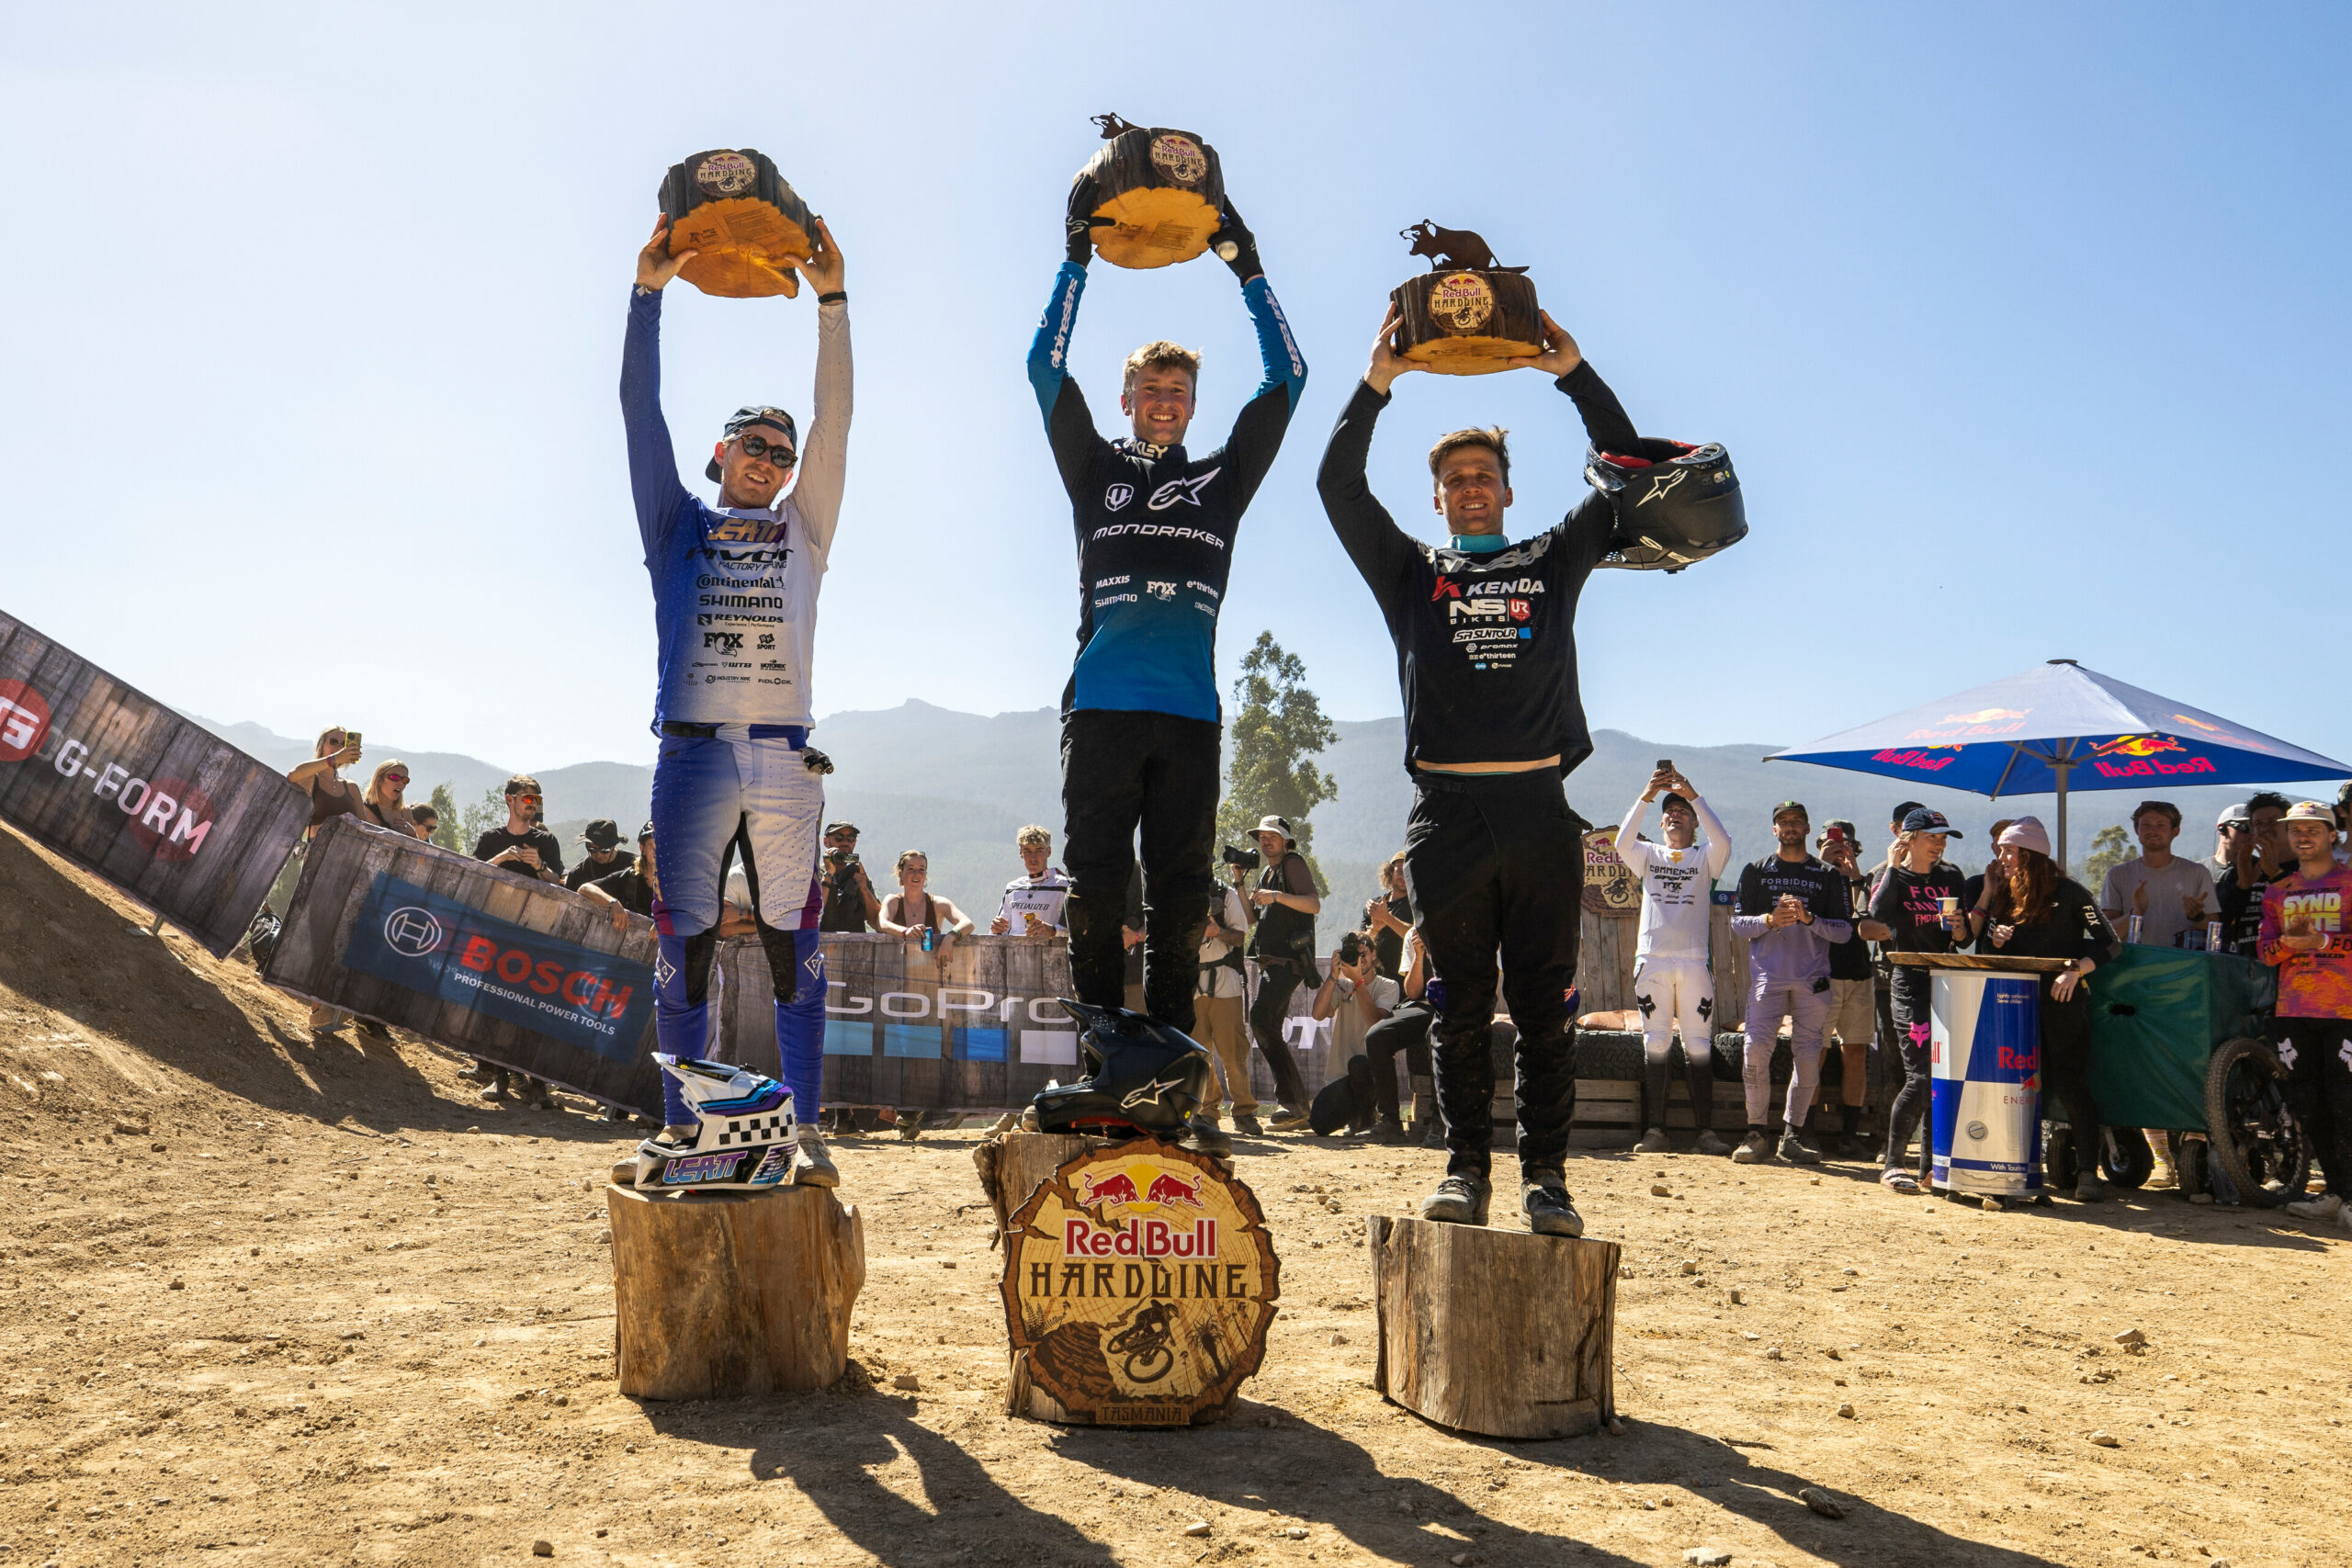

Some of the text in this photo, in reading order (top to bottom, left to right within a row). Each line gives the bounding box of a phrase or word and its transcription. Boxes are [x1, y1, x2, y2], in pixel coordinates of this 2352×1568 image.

[1154, 151, 1204, 166] HARDLINE
[1161, 144, 1195, 157] Red Bull
[700, 167, 752, 179] HARDLINE
[707, 161, 744, 172] Red Bull
[1442, 287, 1481, 299] Red Bull
[1434, 296, 1489, 309] HARDLINE
[1091, 523, 1225, 551] MONDRAKER
[718, 561, 762, 571] FACTORY
[695, 573, 776, 590] Continental
[1095, 574, 1131, 590] MAXXIS
[1146, 581, 1178, 598] FOX
[1465, 578, 1545, 597] KENDA
[698, 594, 784, 609] SHIMANO
[1094, 593, 1138, 608] SHIMANO
[1449, 598, 1507, 617] NS
[714, 614, 784, 624] REYNOLDS
[1450, 615, 1506, 626] BIKES
[703, 631, 744, 651] FOX
[53, 738, 213, 855] G-FORM
[1586, 852, 1613, 863] Red
[1760, 878, 1823, 890] FORBIDDEN
[1909, 886, 1951, 899] FOX
[2283, 892, 2342, 916] SYND
[2082, 904, 2101, 926] FOX
[461, 934, 634, 1021] BOSCH
[454, 972, 616, 1036] PROFESSIONAL POWER TOOLS
[826, 980, 1078, 1025] GoPro
[1997, 1045, 2037, 1070] Red
[662, 1150, 749, 1185] LEATT
[1990, 1162, 2007, 1171] With
[1064, 1217, 1218, 1258] Red Bull
[1029, 1262, 1250, 1299] HARDLINE
[1102, 1405, 1183, 1423] TASMANIA
